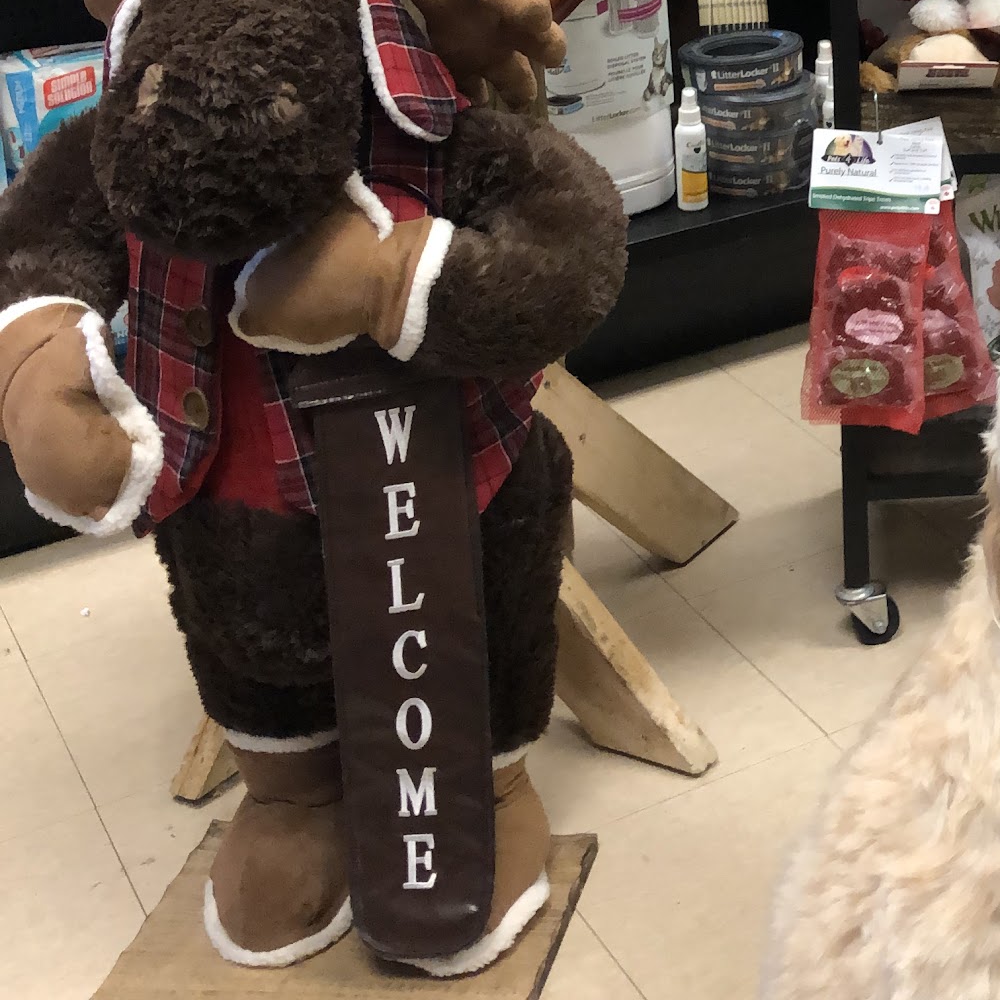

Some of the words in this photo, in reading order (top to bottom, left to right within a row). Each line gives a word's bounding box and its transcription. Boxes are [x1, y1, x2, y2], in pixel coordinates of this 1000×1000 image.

[50, 70, 87, 93] SIMPLE
[716, 67, 769, 80] LitterLocker
[47, 80, 93, 107] SOLUTION
[820, 166, 846, 177] Purely
[847, 167, 877, 177] Natural
[373, 402, 438, 890] WELCOME
